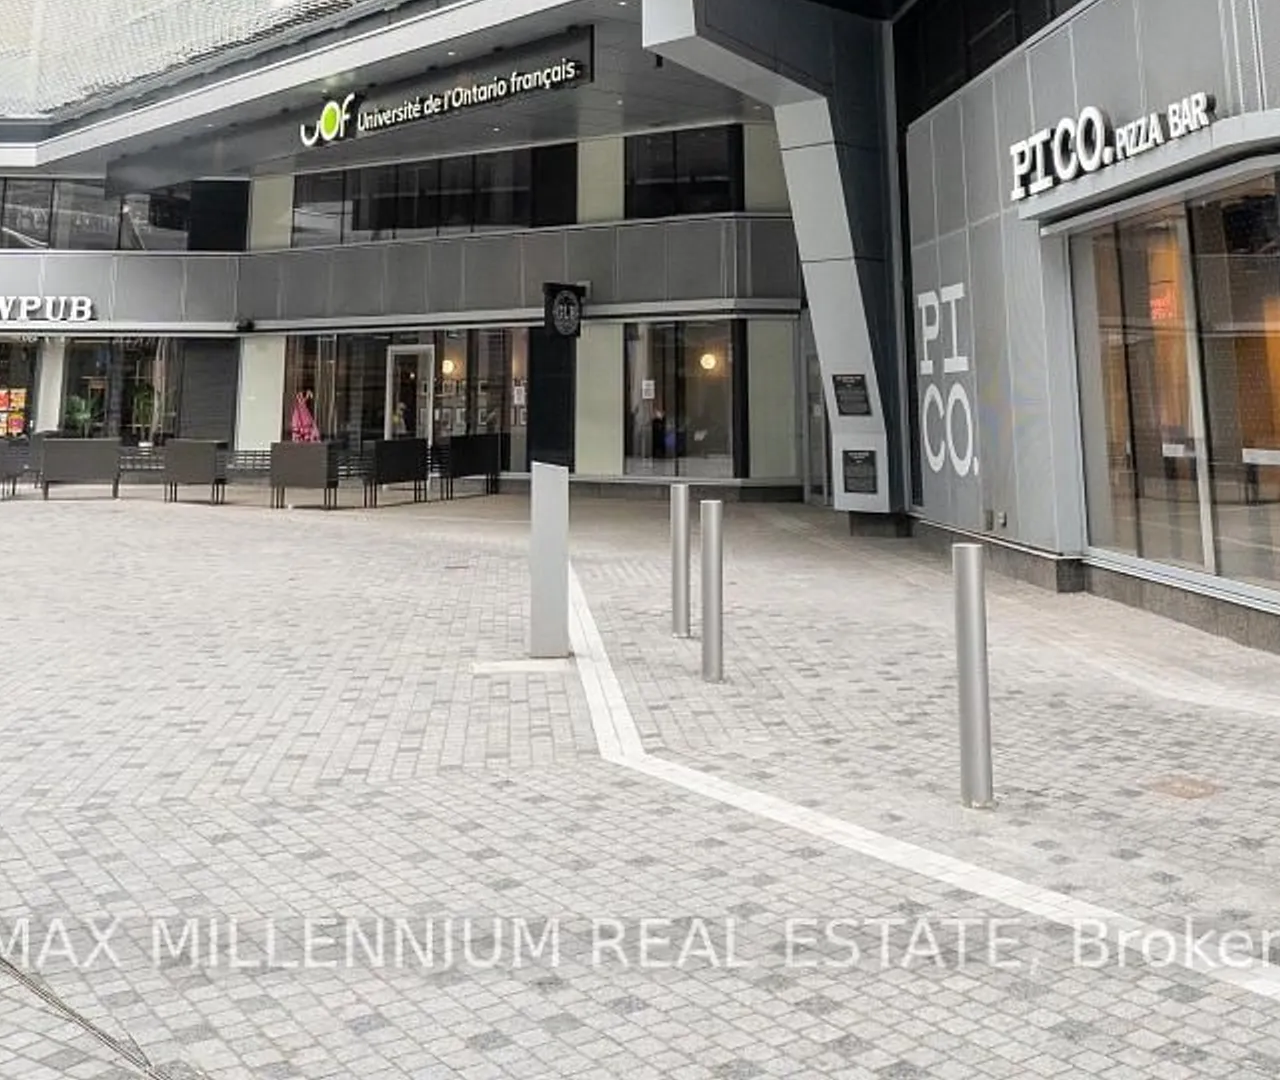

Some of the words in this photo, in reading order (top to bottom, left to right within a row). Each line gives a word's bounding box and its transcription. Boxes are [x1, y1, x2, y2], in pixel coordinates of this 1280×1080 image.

[358, 96, 421, 131] Université
[424, 97, 441, 116] de
[444, 79, 506, 110] l'Ontario
[510, 58, 576, 92] français
[1115, 112, 1165, 160] PIZZA
[1168, 92, 1210, 139] BAR
[918, 282, 970, 375] PI
[923, 382, 980, 477] CO.
